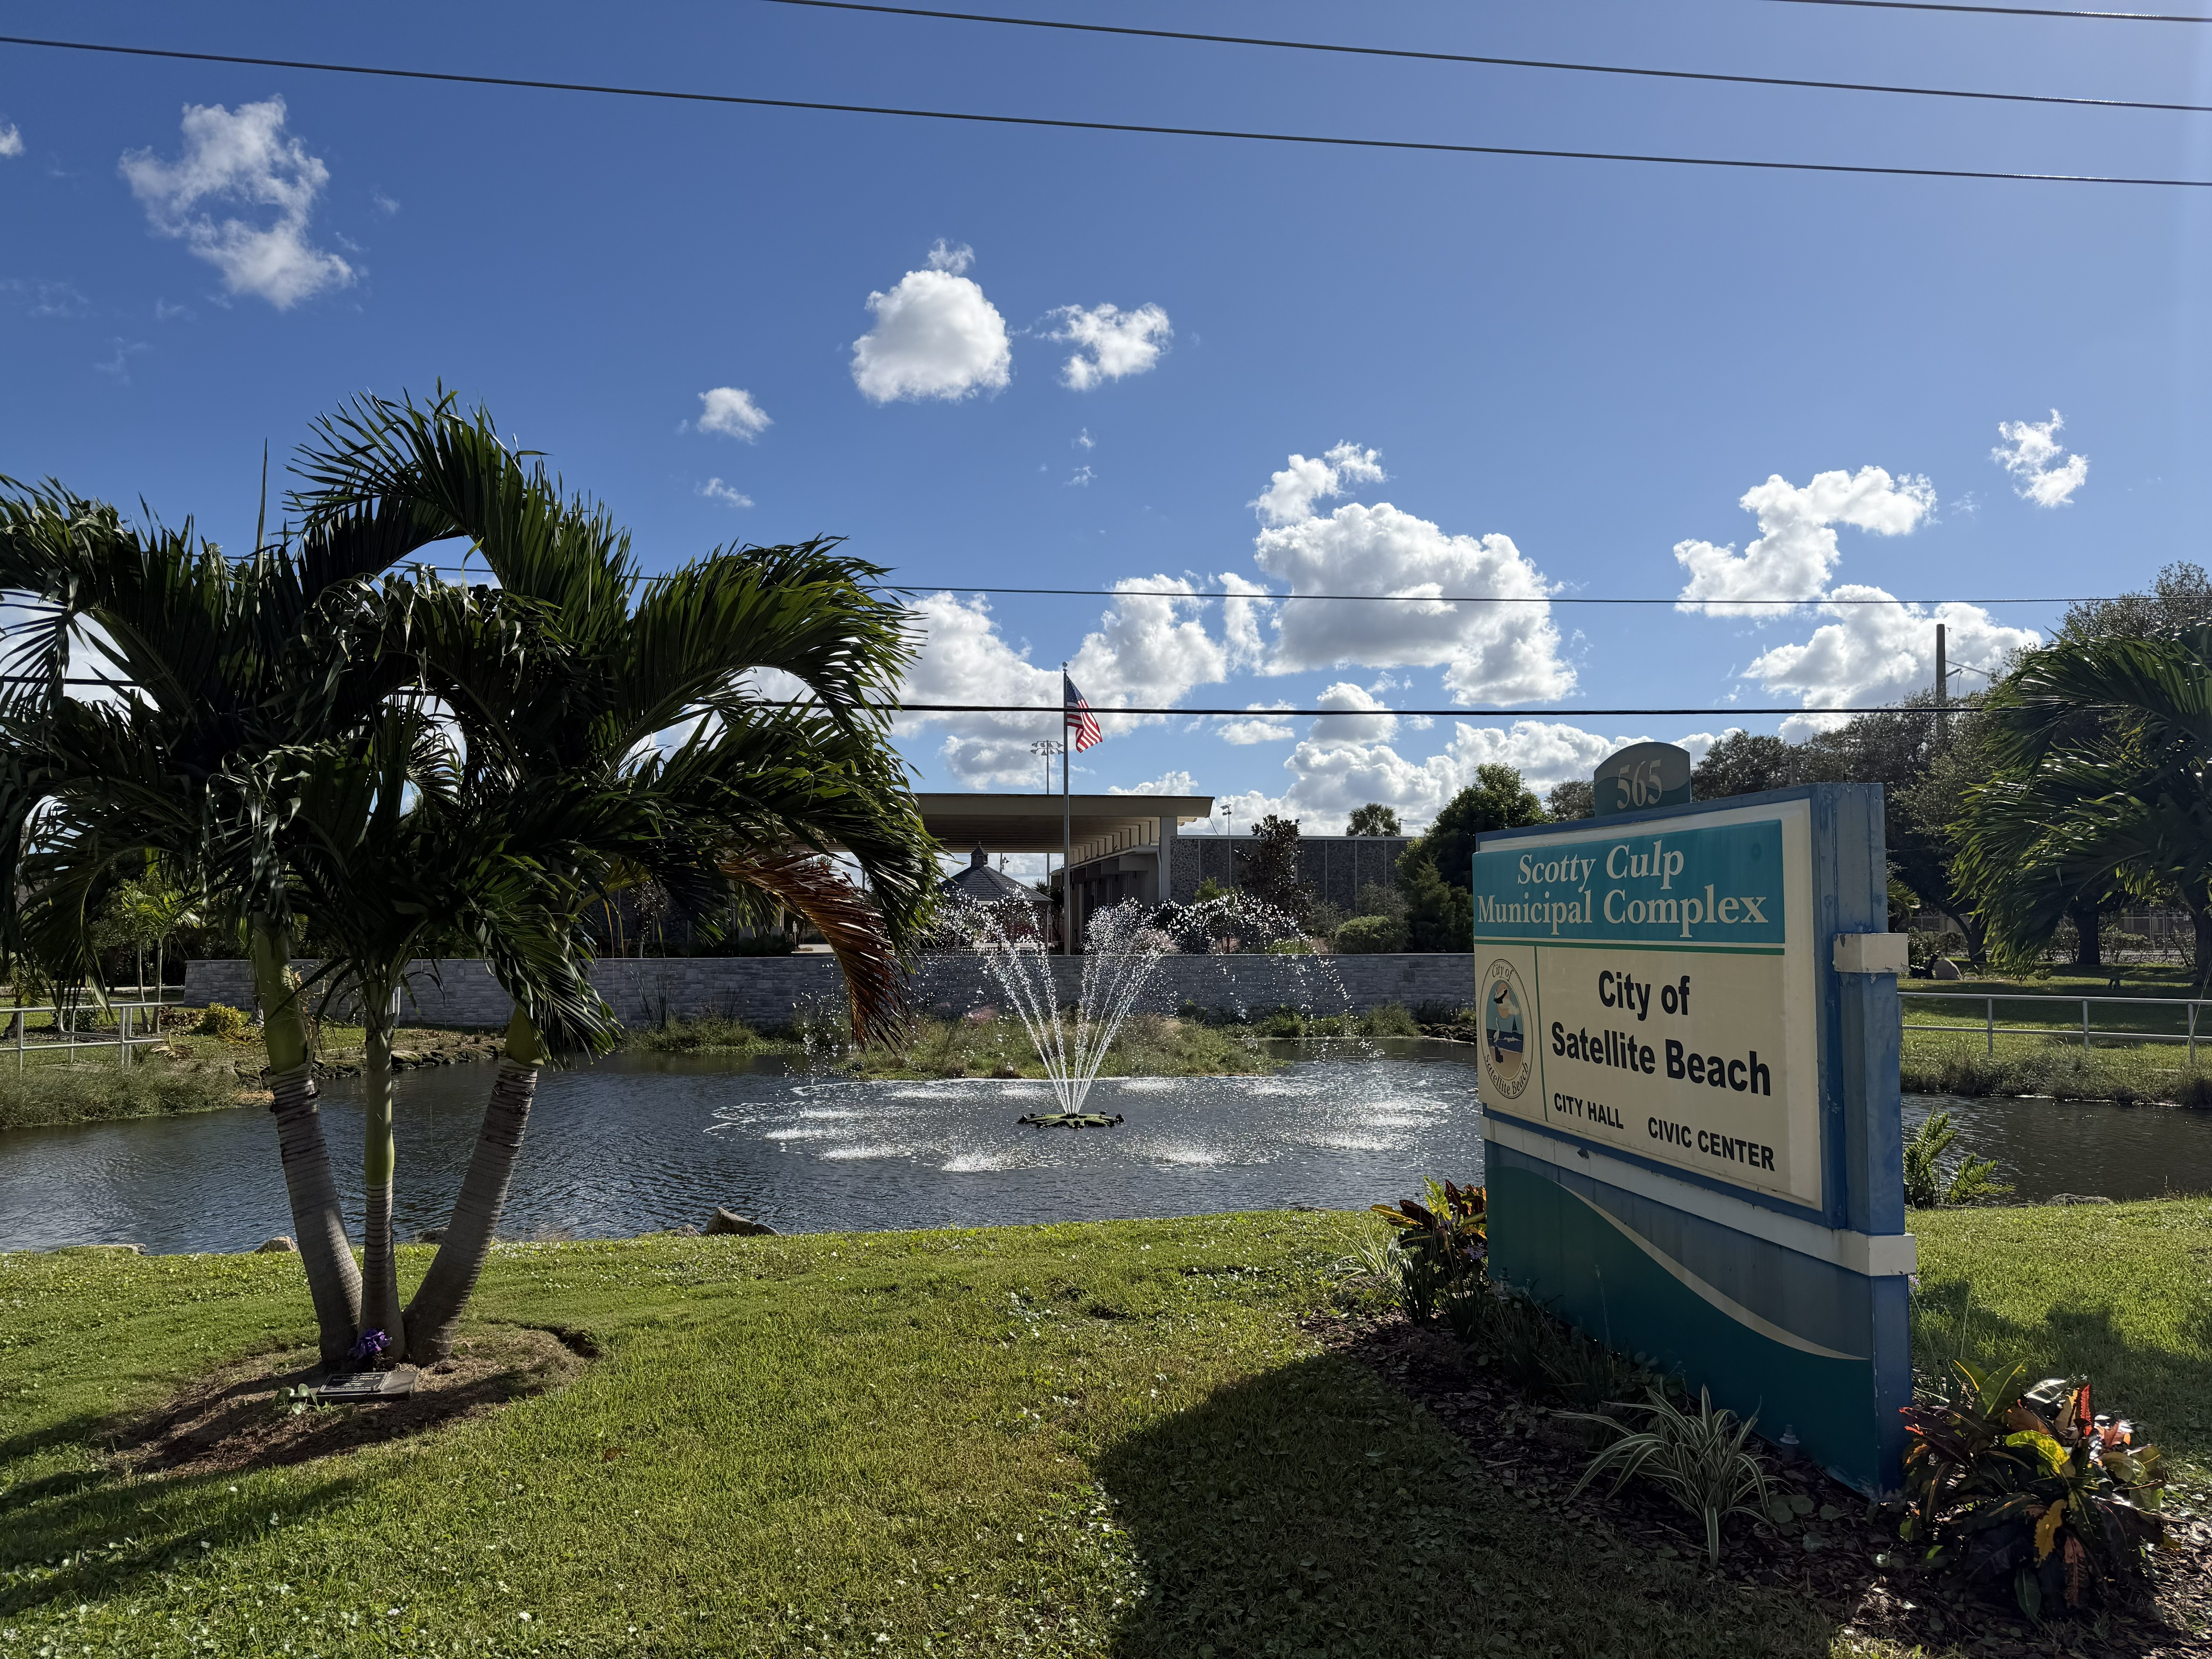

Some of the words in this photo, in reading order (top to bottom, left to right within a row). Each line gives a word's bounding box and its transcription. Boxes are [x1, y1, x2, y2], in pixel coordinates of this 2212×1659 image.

[1617, 759, 1662, 809] 565
[1517, 853, 1595, 892] Scotty
[1606, 840, 1684, 890] Culp
[1478, 889, 1592, 936] Municipal
[1603, 884, 1769, 938] Complex
[1492, 963, 1504, 979] City
[1505, 968, 1514, 981] of
[1599, 970, 1651, 1021] City
[1661, 975, 1690, 1015] of
[1485, 1054, 1510, 1095] Satellite
[1512, 1061, 1528, 1095] Beach
[1552, 1022, 1655, 1074] Satellite
[1665, 1039, 1771, 1096] Beach
[1554, 1092, 1583, 1118] CITY
[1587, 1101, 1624, 1130] HALL
[1648, 1117, 1692, 1148] CIVIC
[1698, 1130, 1775, 1171] CENTER
